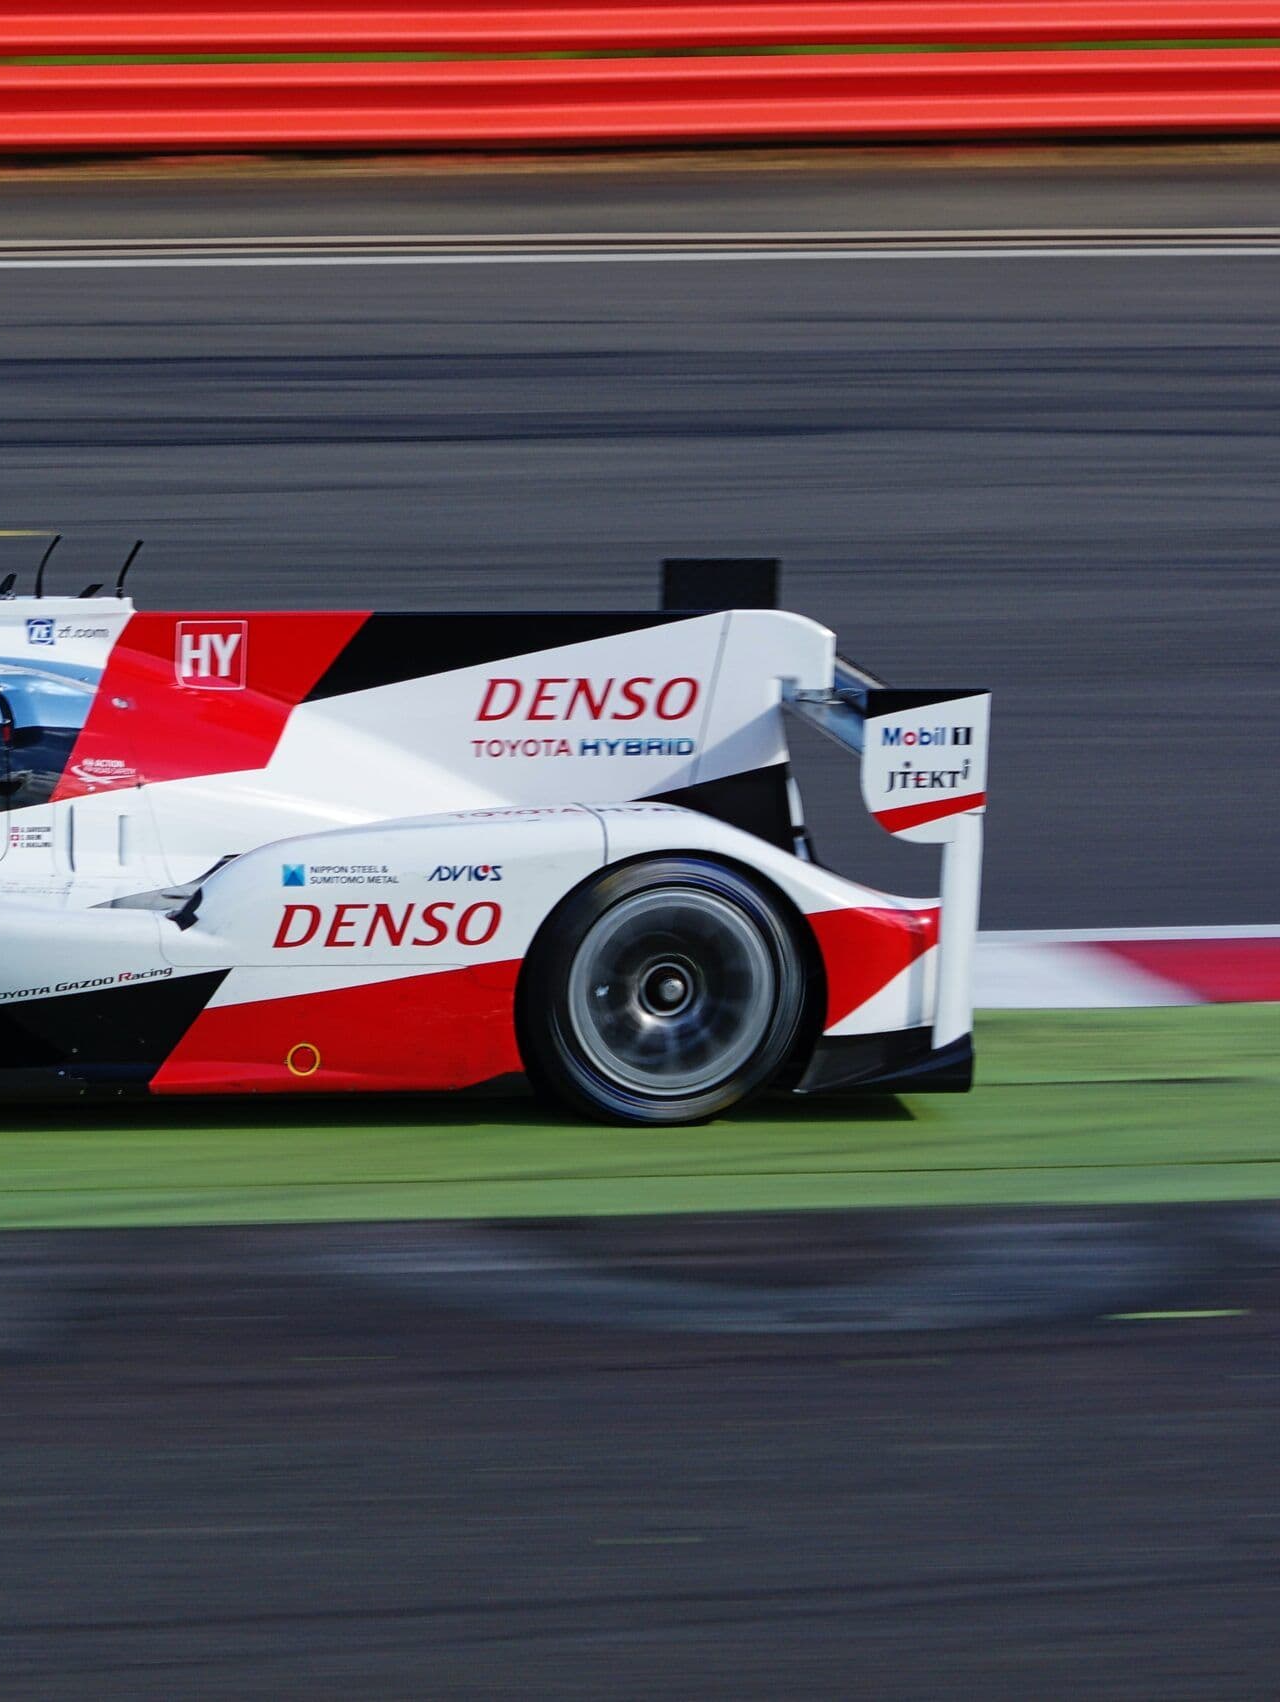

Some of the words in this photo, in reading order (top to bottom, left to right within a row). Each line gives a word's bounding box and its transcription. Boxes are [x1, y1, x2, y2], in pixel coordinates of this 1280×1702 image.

[181, 633, 242, 678] HY
[475, 677, 700, 721] DENSO
[881, 727, 946, 746] Mobil
[951, 726, 973, 746] 1
[470, 738, 573, 758] TOYOTA
[578, 737, 696, 757] HYBRID
[310, 866, 348, 874] NIPPON
[350, 866, 379, 874] STEEL
[310, 876, 365, 884] SUMITOMO
[367, 876, 399, 884] METAL
[427, 865, 503, 882] ADVICS
[272, 901, 502, 948] DENSO
[55, 976, 114, 992] GAZOO
[118, 967, 173, 983] Racing
